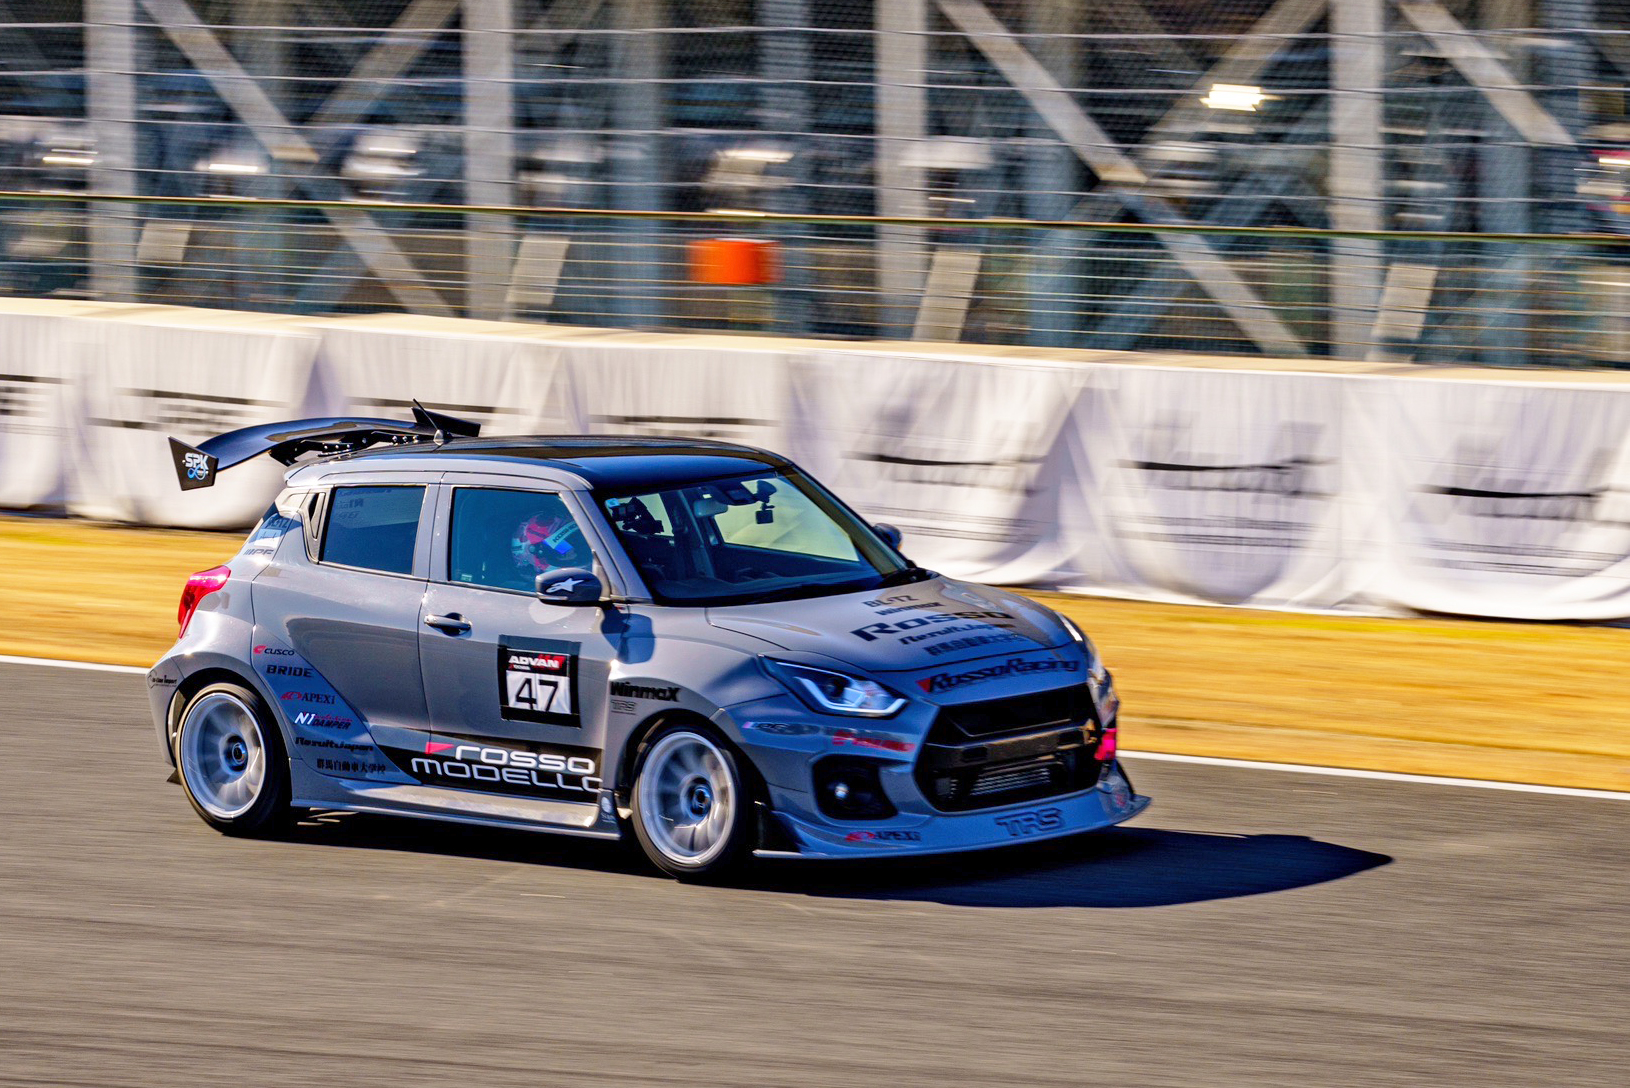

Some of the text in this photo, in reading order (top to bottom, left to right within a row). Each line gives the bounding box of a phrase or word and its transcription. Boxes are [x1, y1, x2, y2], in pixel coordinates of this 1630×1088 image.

[185, 452, 209, 470] SPK
[264, 647, 295, 656] CUSCO
[508, 655, 560, 669] ADVAN
[266, 664, 315, 678] BRIDE
[515, 677, 559, 712] 47
